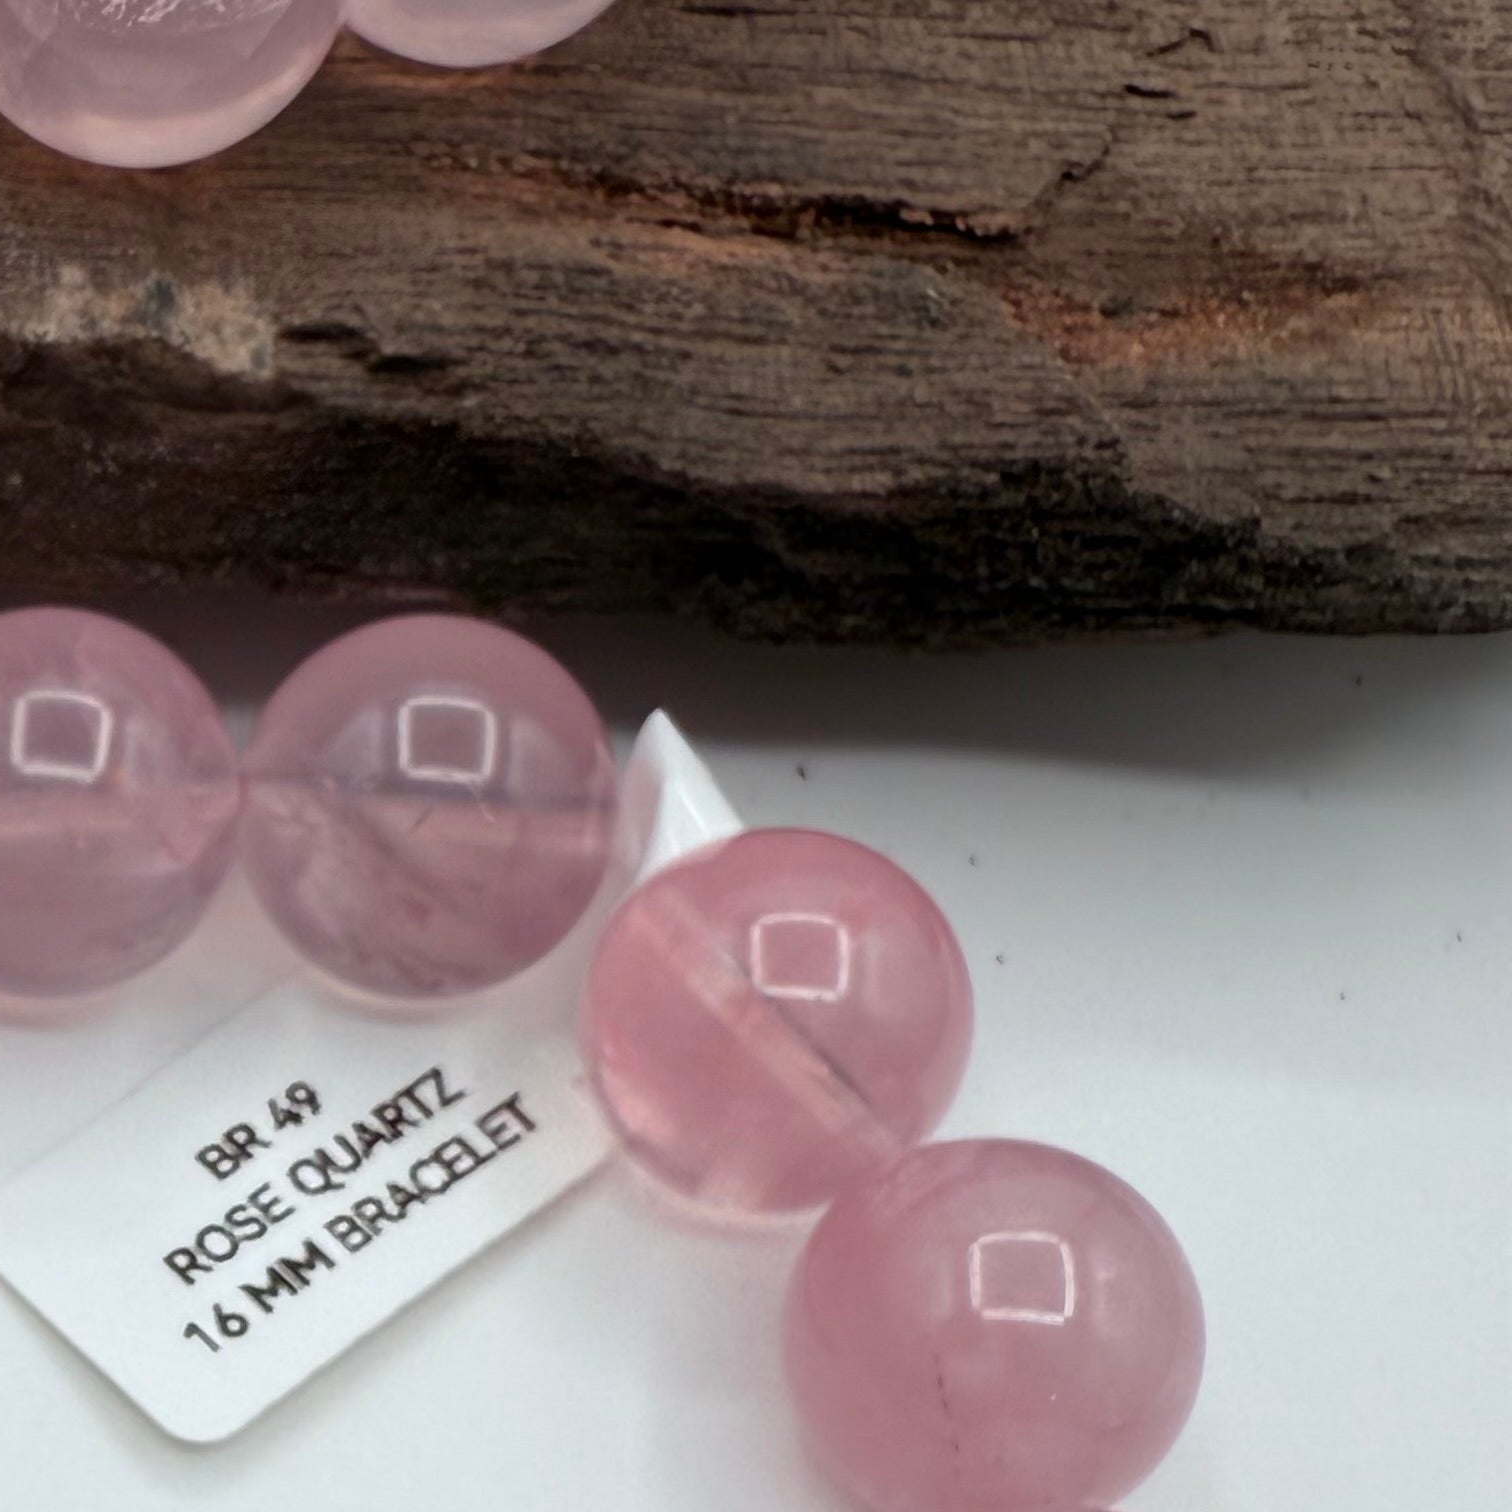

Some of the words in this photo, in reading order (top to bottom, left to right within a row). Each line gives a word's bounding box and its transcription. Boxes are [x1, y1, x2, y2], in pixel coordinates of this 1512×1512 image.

[162, 1182, 296, 1286] ROSE
[287, 1066, 466, 1196] QUARTZ
[183, 1303, 250, 1352] 16
[239, 1238, 337, 1313] MM
[324, 1091, 537, 1253] BRACELET
[194, 1122, 271, 1181] BR
[267, 1081, 322, 1131] 49
